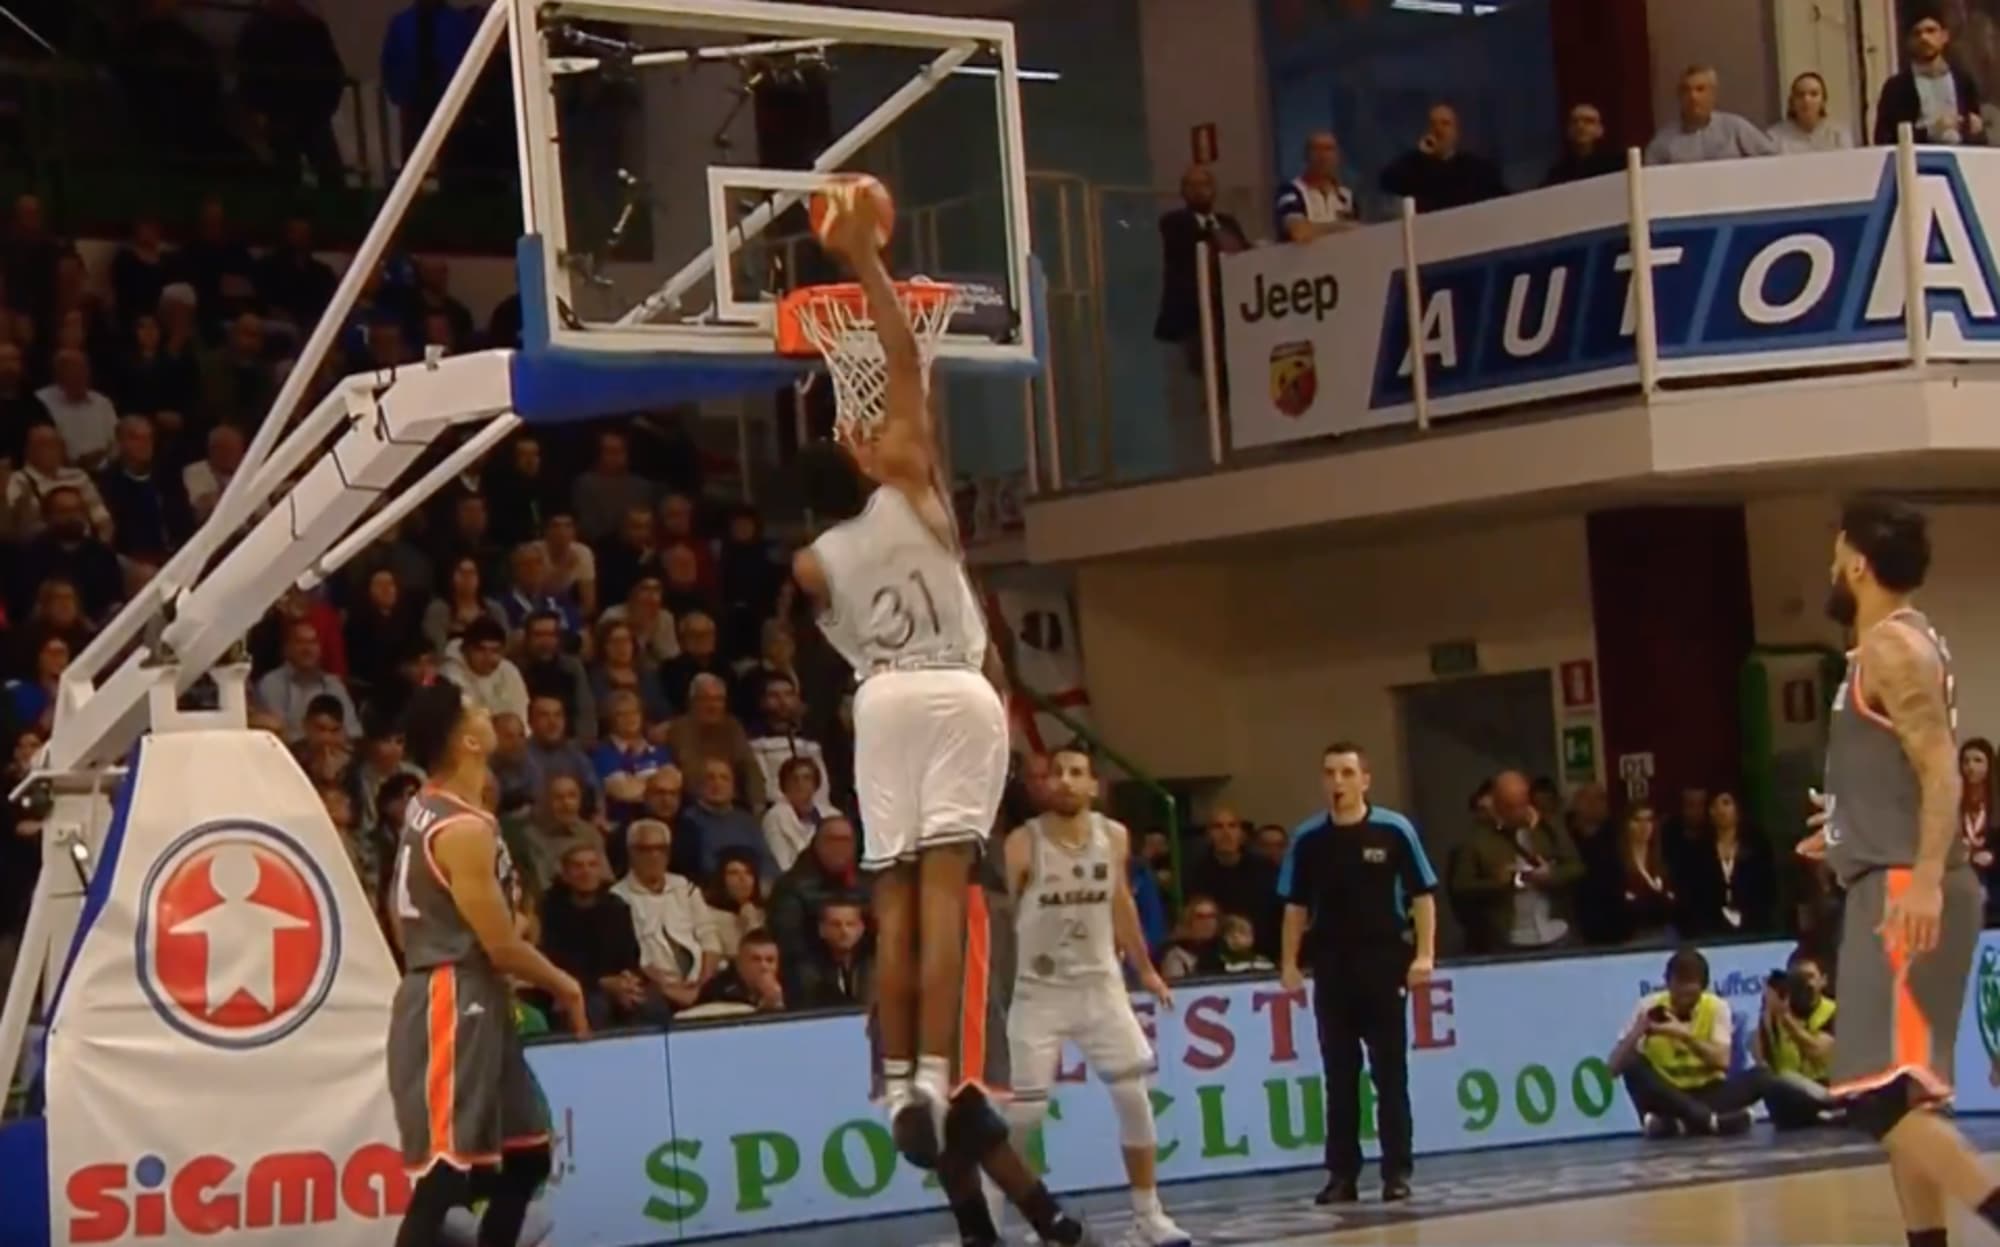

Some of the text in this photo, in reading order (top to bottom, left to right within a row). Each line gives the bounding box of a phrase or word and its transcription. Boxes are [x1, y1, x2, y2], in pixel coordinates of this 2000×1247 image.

[1239, 272, 1339, 323] Jeep
[872, 568, 940, 649] 31
[1457, 1056, 1614, 1132] 900
